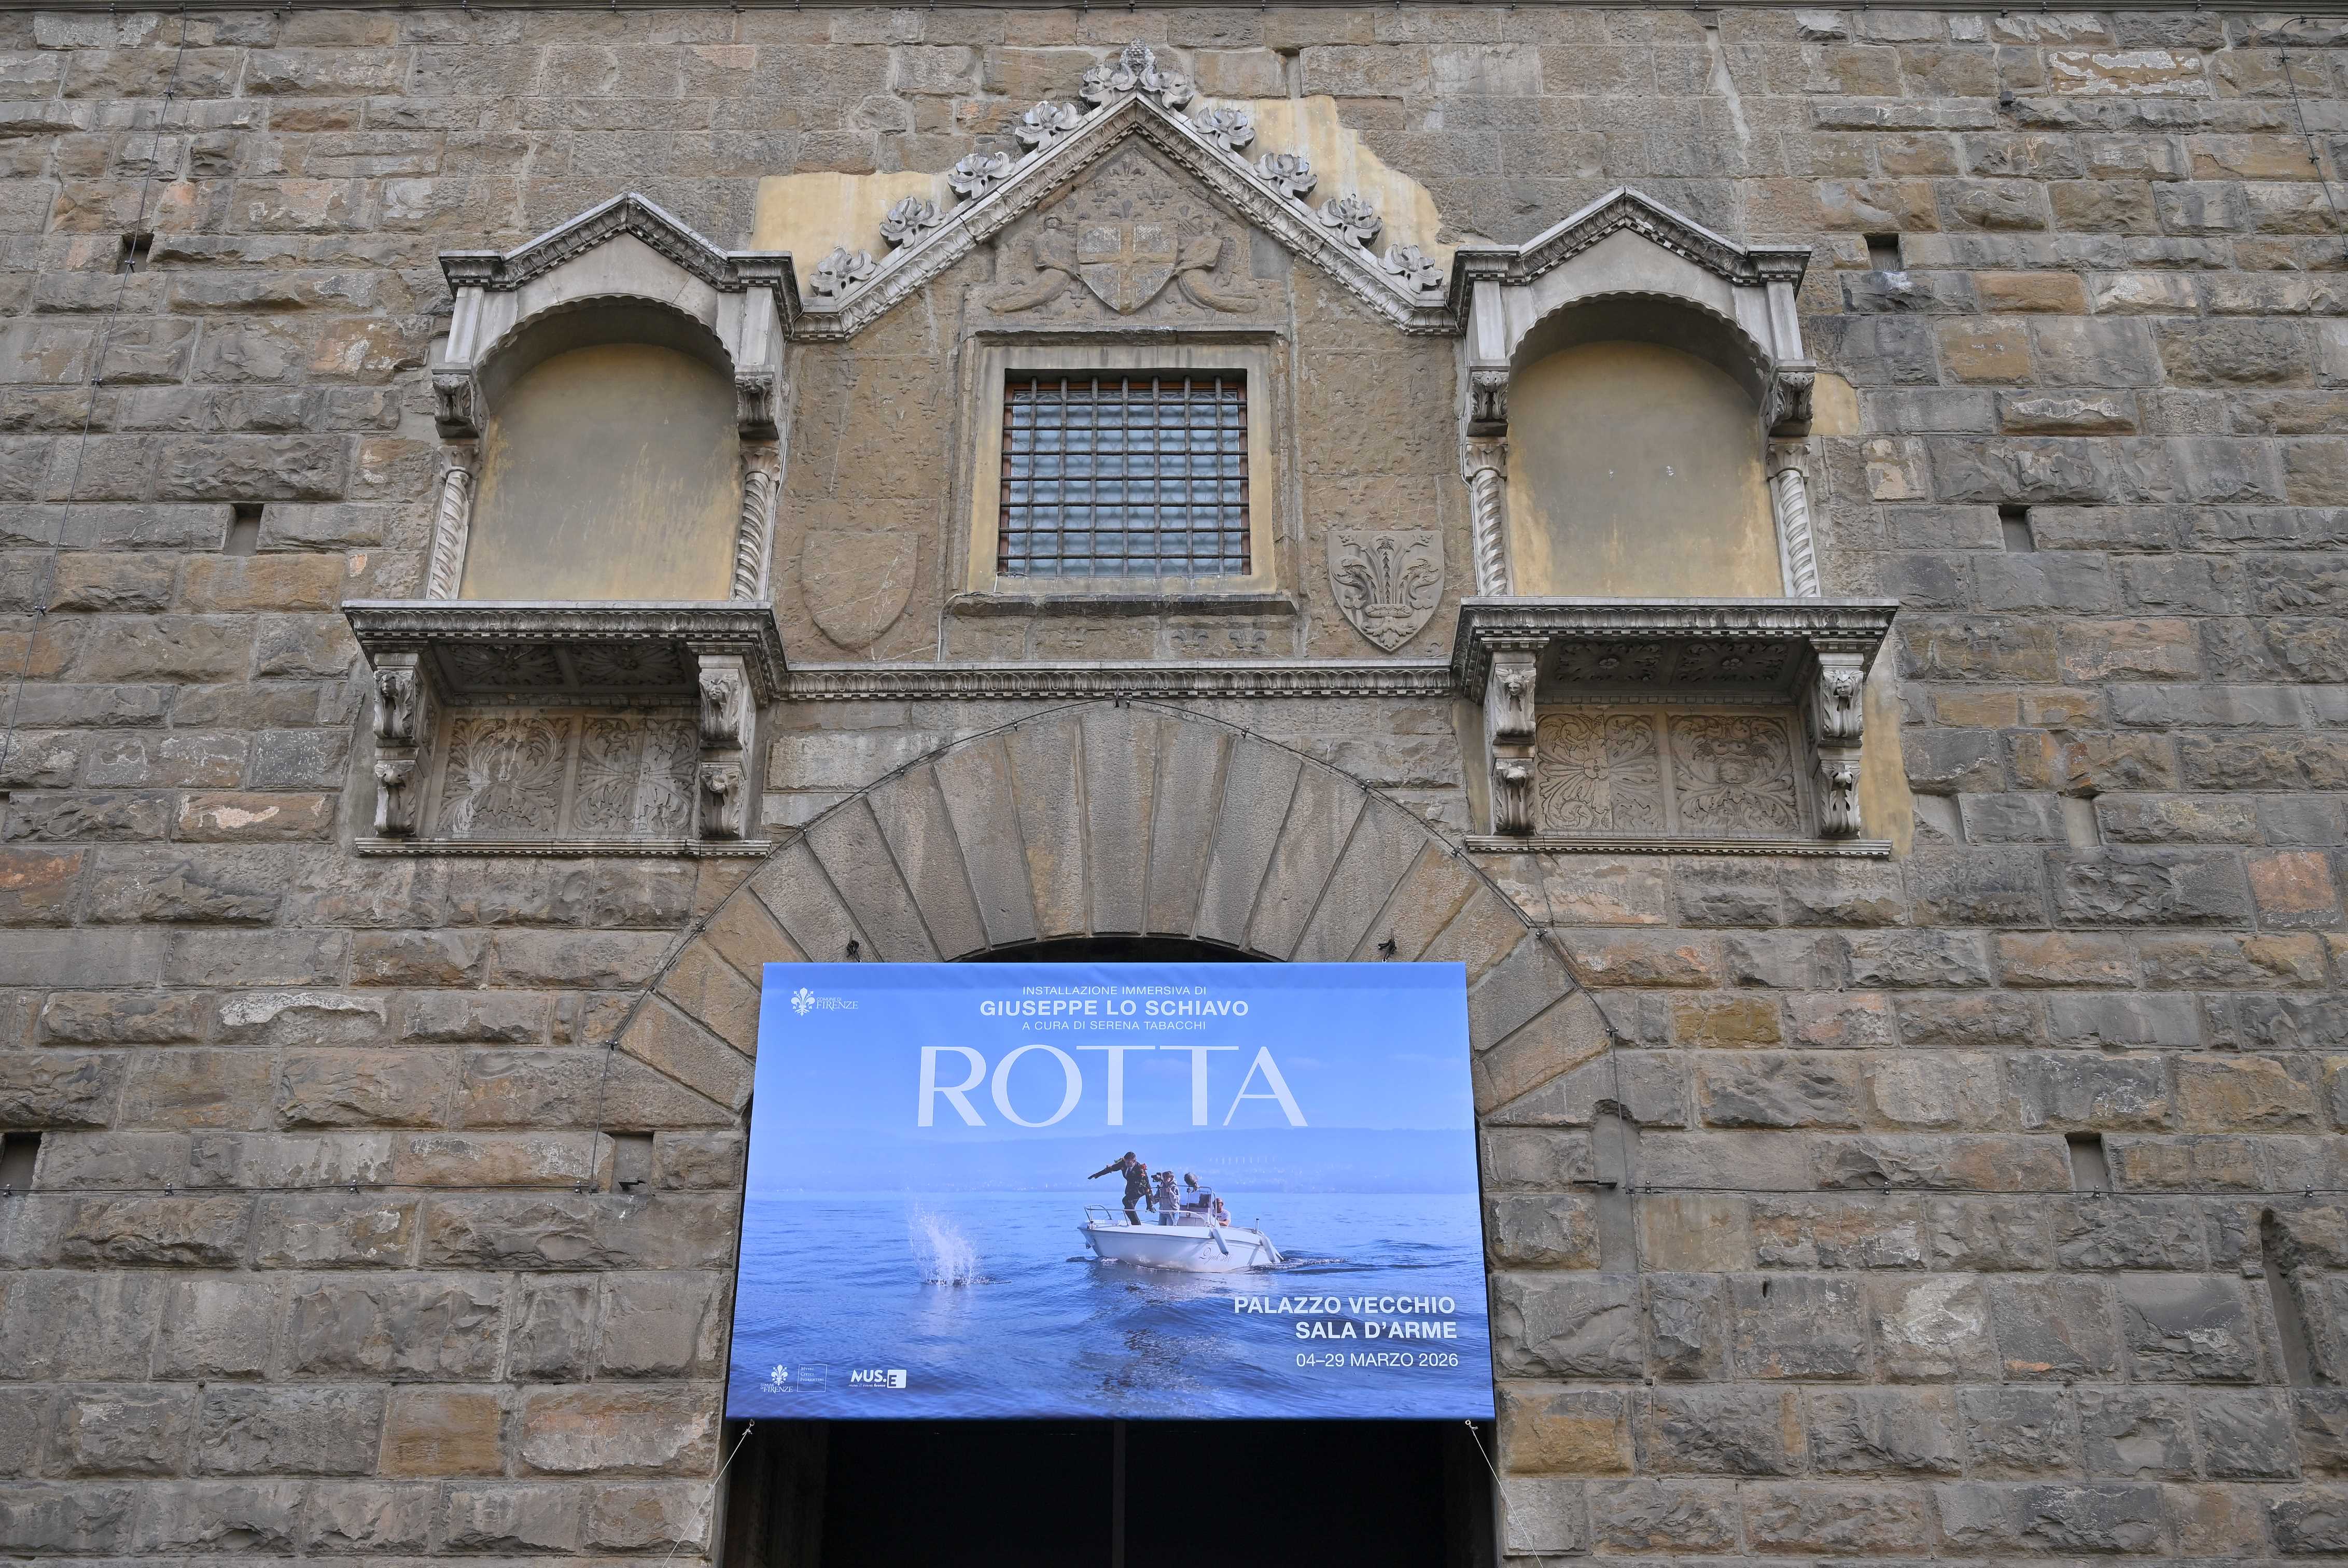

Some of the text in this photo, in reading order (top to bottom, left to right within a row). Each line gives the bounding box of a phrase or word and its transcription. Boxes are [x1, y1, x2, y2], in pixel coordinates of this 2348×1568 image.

[1023, 986, 1207, 995] INSTALLAZIONE IMMERSIVA DI
[816, 1001, 859, 1011] FIRENZE
[980, 1000, 1249, 1016] GIUSEPPE LO SCHIAVO
[1022, 1021, 1206, 1030] A CURA DI SERENA TABACCHI
[917, 1044, 1308, 1128] ROTTA
[1234, 1296, 1456, 1314] PALAZZO VECCHIO
[1295, 1321, 1457, 1339] SALA D’ARME
[1350, 1352, 1414, 1367] MARZO
[1418, 1352, 1459, 1367] 2026
